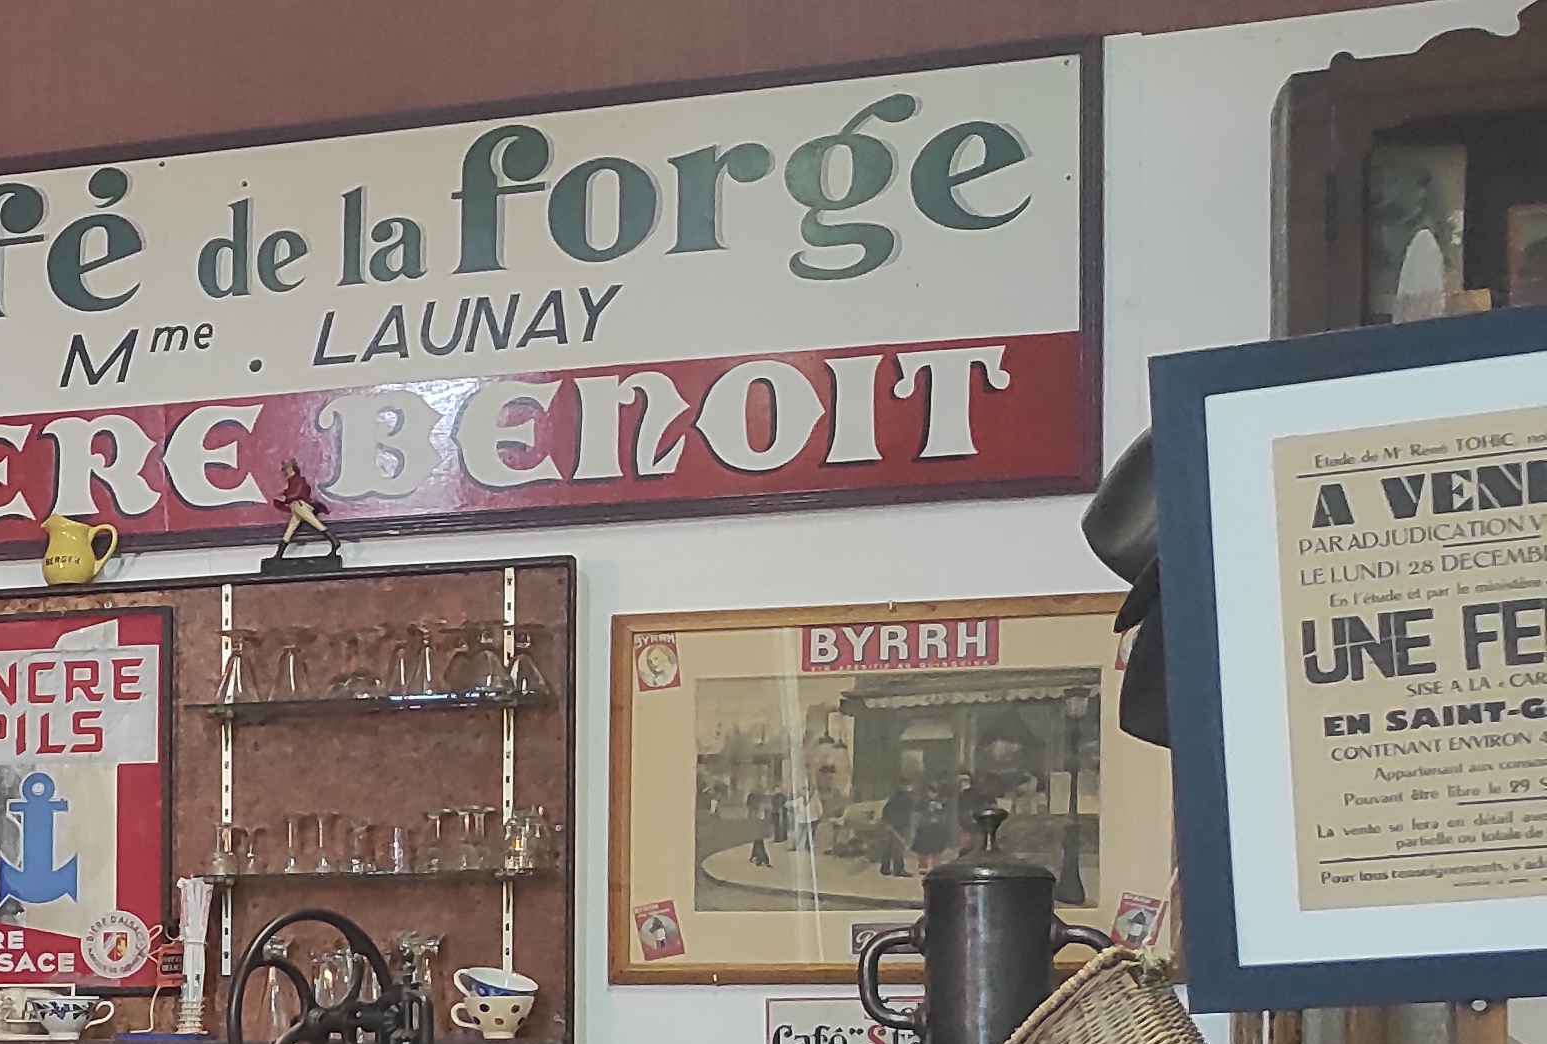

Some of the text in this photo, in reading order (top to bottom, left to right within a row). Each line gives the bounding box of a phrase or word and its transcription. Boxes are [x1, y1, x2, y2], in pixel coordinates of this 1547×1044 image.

[198, 199, 305, 298] de
[341, 188, 425, 286] la
[452, 95, 1032, 281] forge
[313, 284, 622, 366] LAUNAY
[1312, 483, 1355, 529] A
[1299, 535, 1344, 555] PAR
[1347, 515, 1525, 551] ADJUDICATION
[1300, 568, 1326, 586] LE
[1331, 560, 1400, 584] LUNDI
[1408, 560, 1434, 576] 28
[1408, 589, 1421, 599] et
[1427, 588, 1450, 602] par
[1457, 583, 1470, 595] le
[809, 619, 990, 663] BYRRH
[1302, 608, 1437, 684] UNE
[1406, 680, 1444, 697] SISE
[1450, 680, 1462, 692] A
[1469, 677, 1491, 691] LA
[1324, 714, 1371, 737] EN
[1331, 731, 1532, 761] CONTENANT ENVIRON
[1343, 792, 1403, 807] Pouvant
[1411, 789, 1439, 801] être
[1489, 781, 1502, 795] le
[1509, 779, 1530, 793] 29
[1317, 824, 1335, 839] La
[1474, 811, 1514, 826] détail
[1458, 834, 1477, 844] ou
[1525, 827, 1543, 839] de
[1321, 871, 1354, 885] Pour
